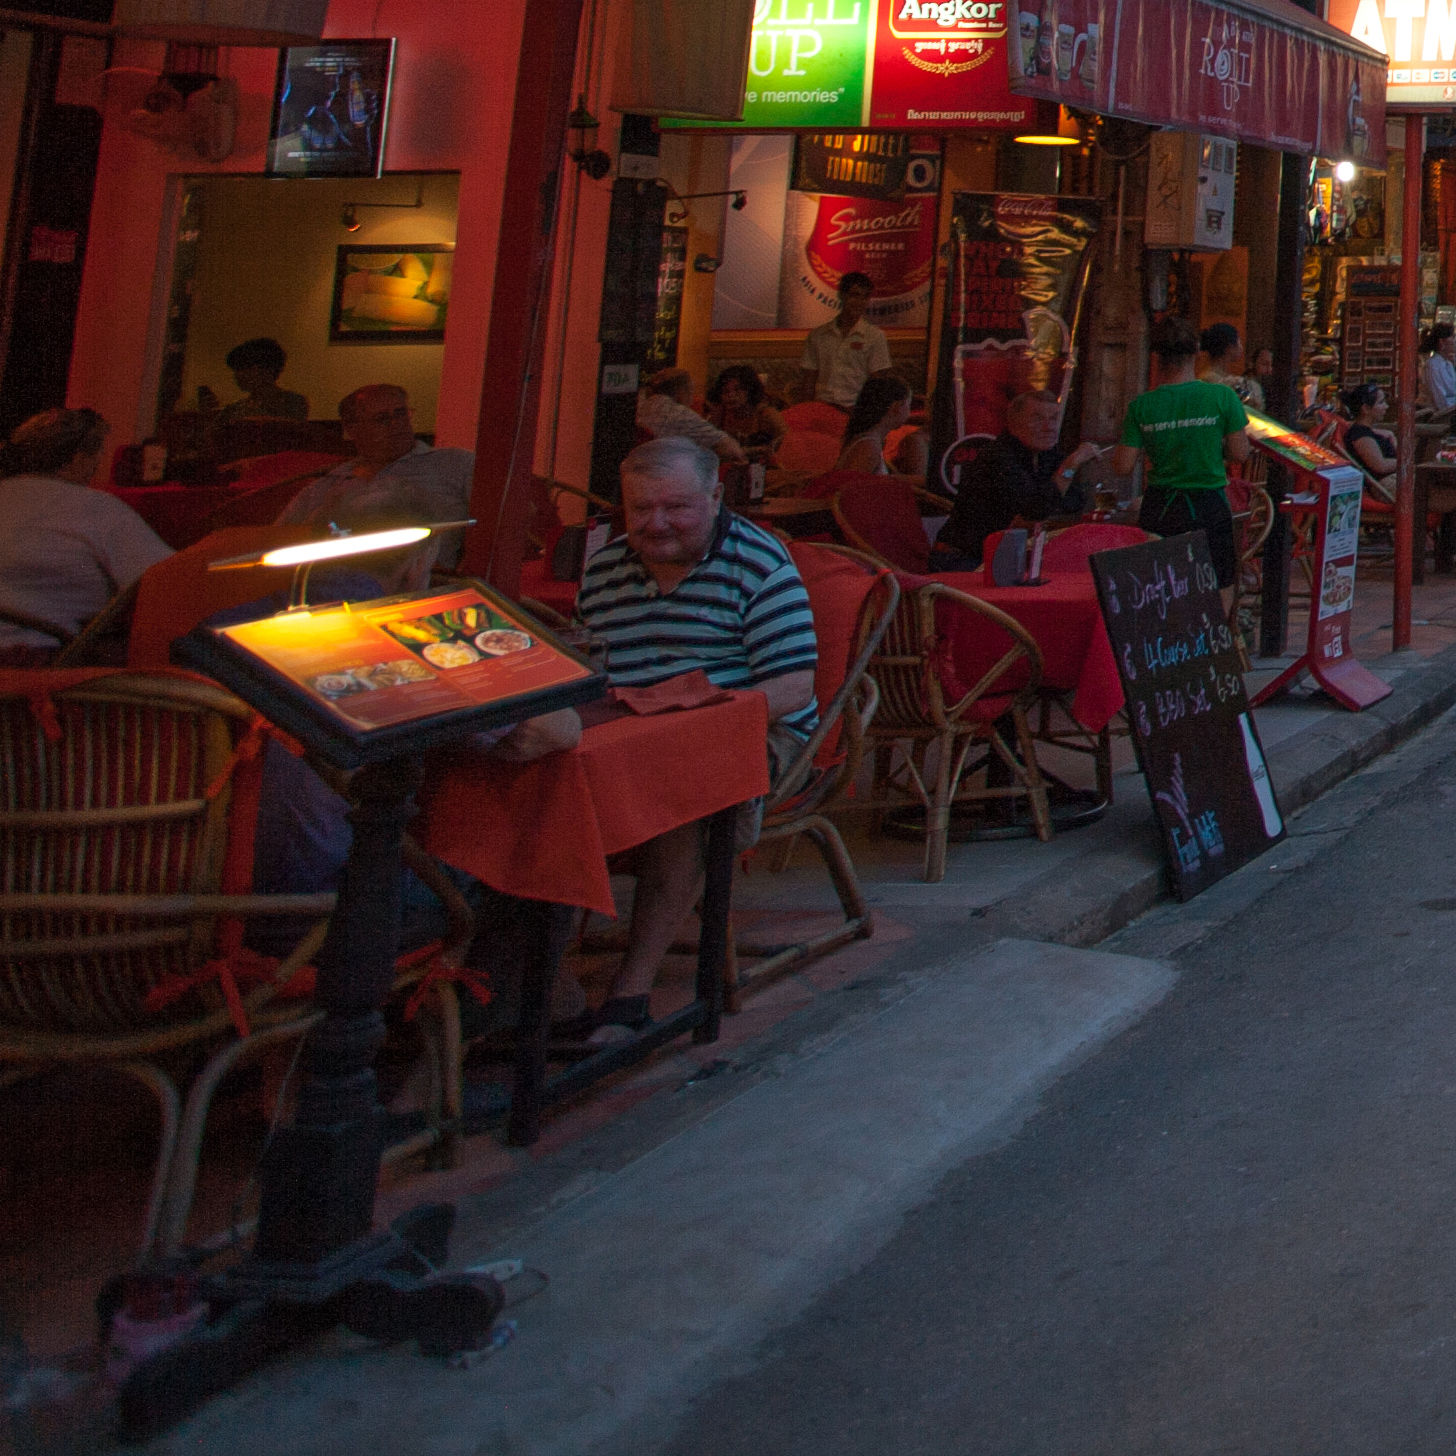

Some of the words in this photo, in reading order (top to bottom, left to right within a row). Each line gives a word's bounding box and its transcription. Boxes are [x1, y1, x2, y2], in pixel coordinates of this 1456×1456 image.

[750, 29, 823, 77] UP
[761, 88, 845, 104] memories"
[827, 201, 924, 247] Smooth
